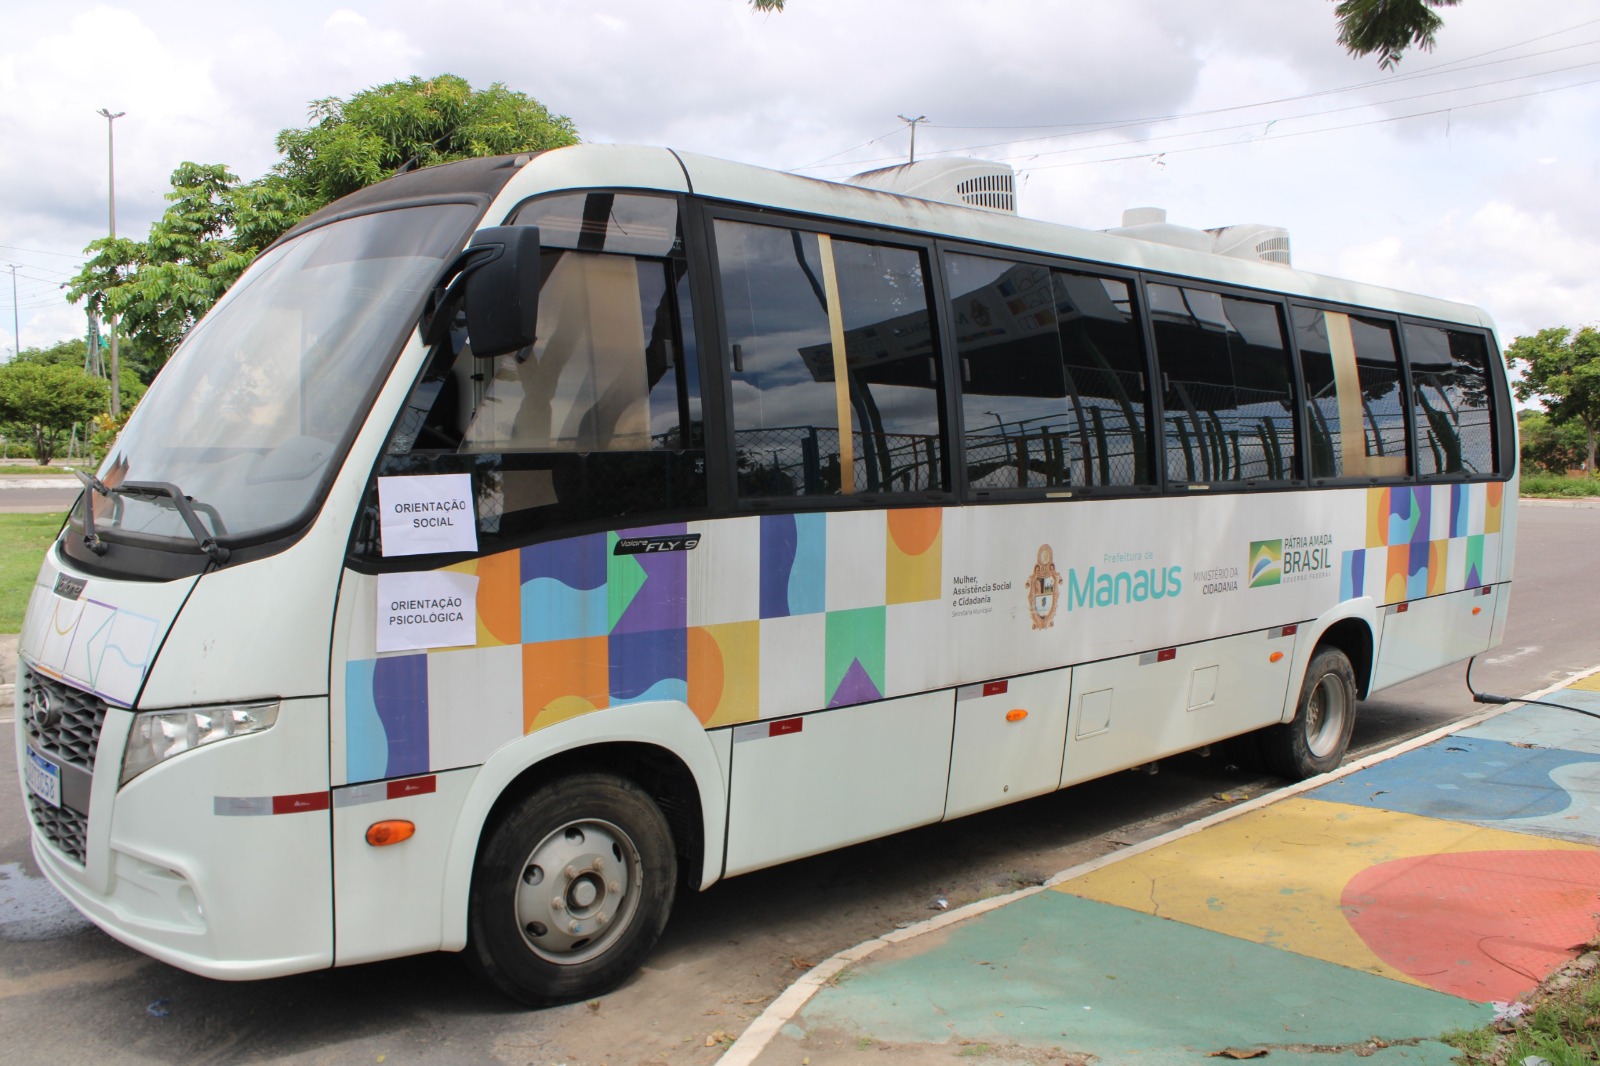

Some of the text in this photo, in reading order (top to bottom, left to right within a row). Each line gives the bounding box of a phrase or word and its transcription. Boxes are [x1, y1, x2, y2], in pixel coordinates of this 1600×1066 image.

[394, 499, 466, 514] ORIENTAÇÃO
[413, 517, 454, 529] SOCIAL
[645, 540, 698, 552] FLY 9
[1284, 534, 1332, 549] PÁTRIA AMADA
[1104, 551, 1154, 563] Prefeitura de
[1283, 548, 1331, 574] BRASIL
[953, 575, 977, 585] Mulher,
[1193, 567, 1238, 583] MINISTÉRIO DA
[953, 581, 1012, 596] Assistência Social
[1067, 565, 1182, 612] Manaus
[1202, 580, 1238, 595] CIDADANIA
[391, 596, 462, 611] ORIENTAÇÃO
[958, 594, 991, 606] Cidadania
[973, 606, 992, 615] Municipal
[389, 612, 463, 626] PSICOLÓGICA
